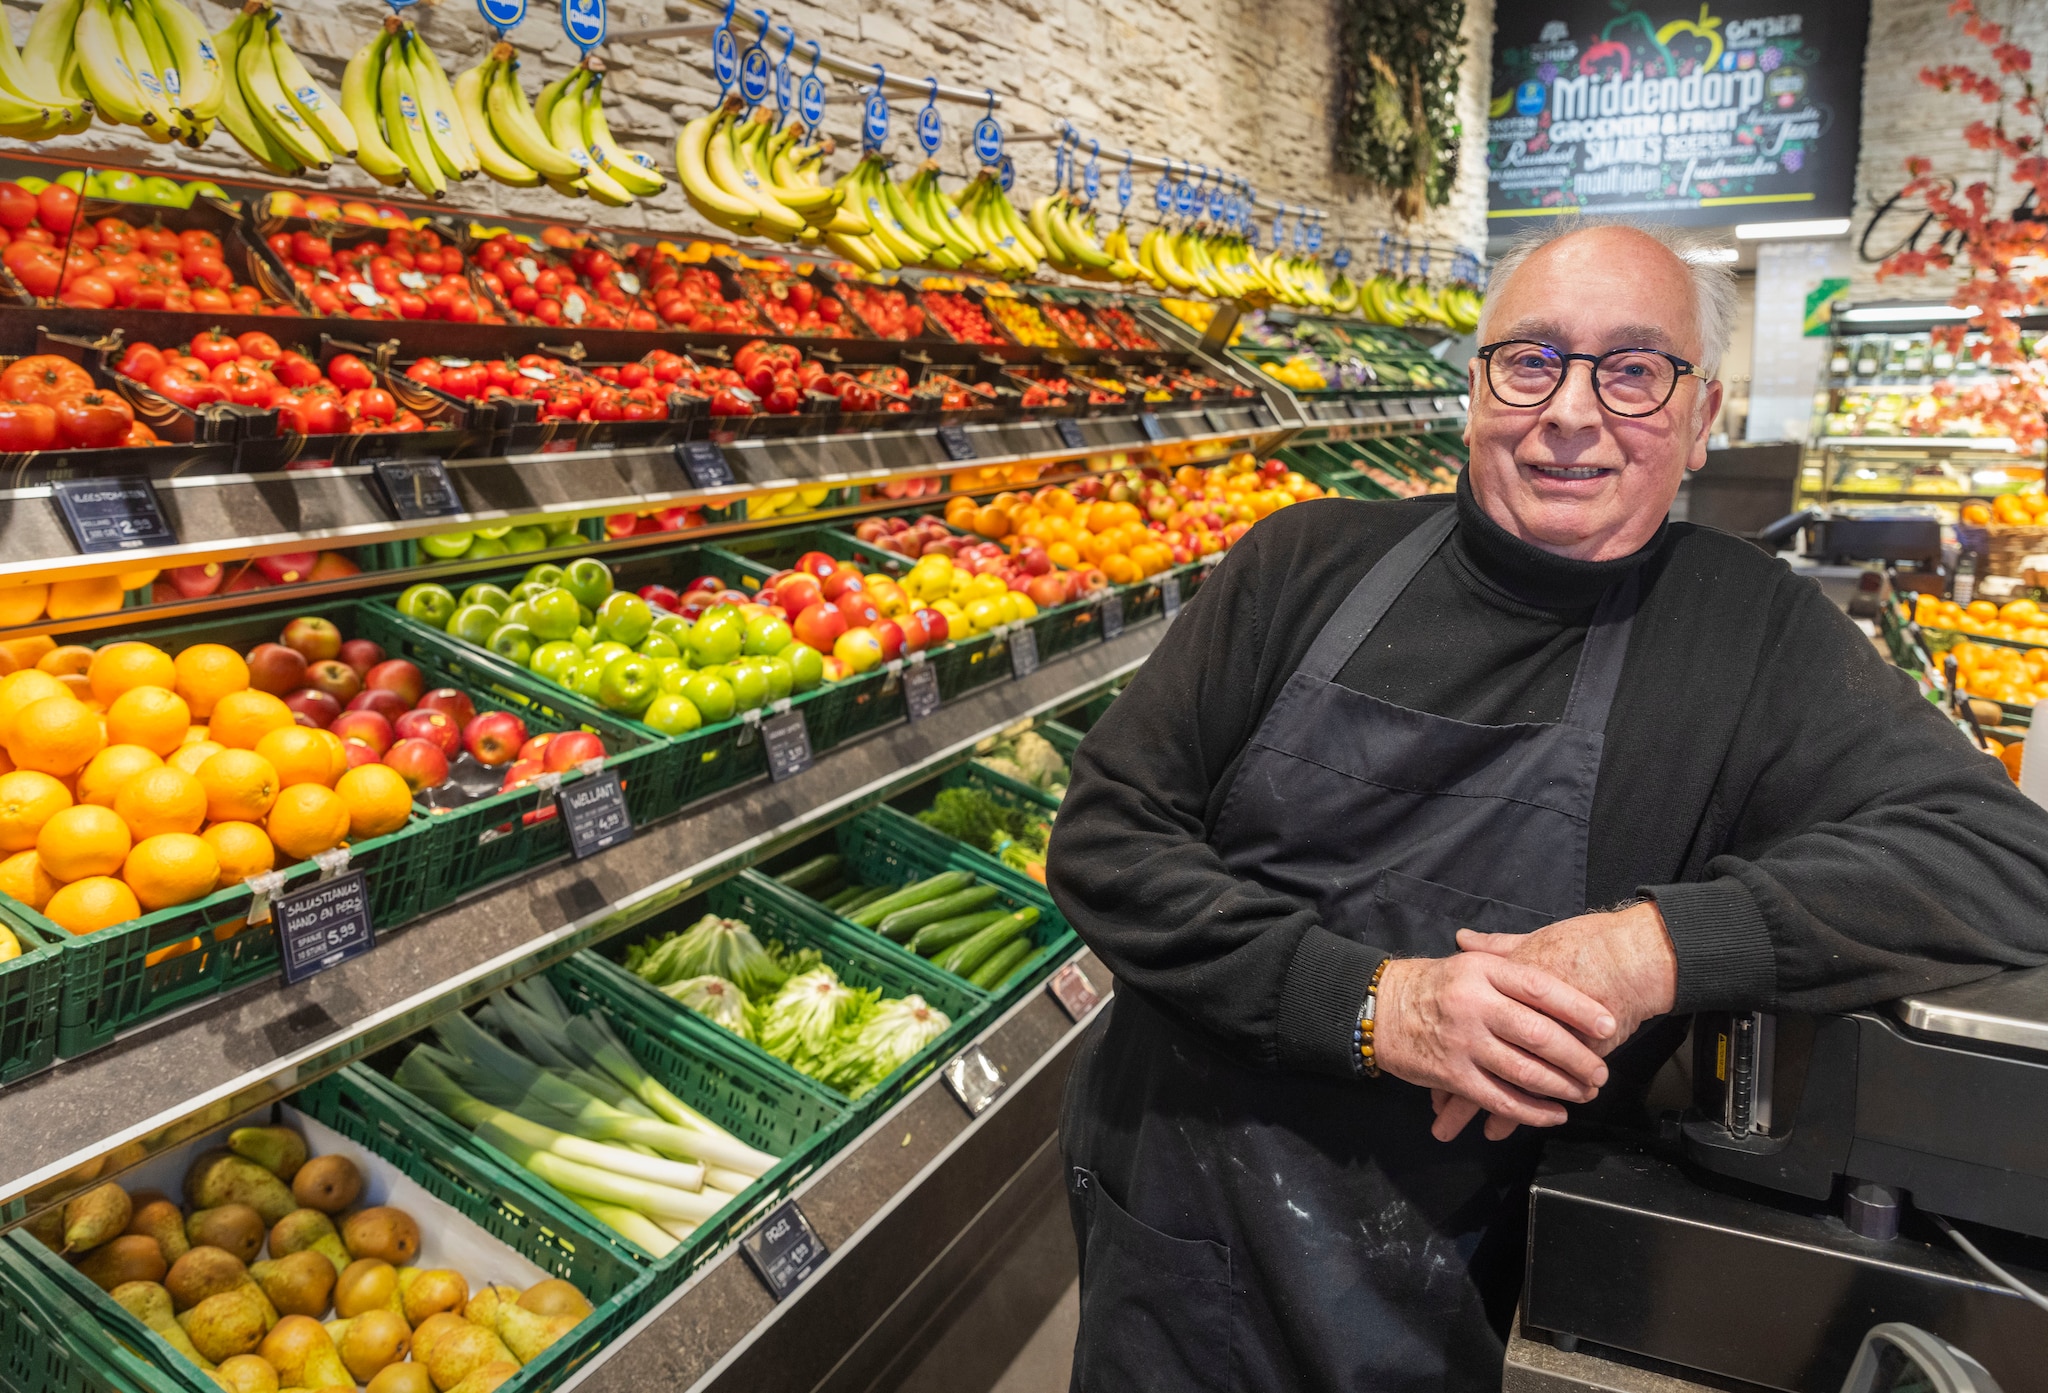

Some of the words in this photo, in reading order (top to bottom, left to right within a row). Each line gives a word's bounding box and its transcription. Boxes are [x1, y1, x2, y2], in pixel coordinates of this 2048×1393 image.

[1551, 63, 1765, 121] Middendorp
[1679, 107, 1738, 134] FRUIT
[569, 782, 615, 809] WELLANT
[286, 882, 360, 917] SALUSTIANUS
[287, 912, 318, 933] HAND
[320, 906, 334, 921] EN
[335, 896, 363, 914] PERS
[327, 921, 357, 945] 5,99
[765, 1218, 791, 1245] PREI
